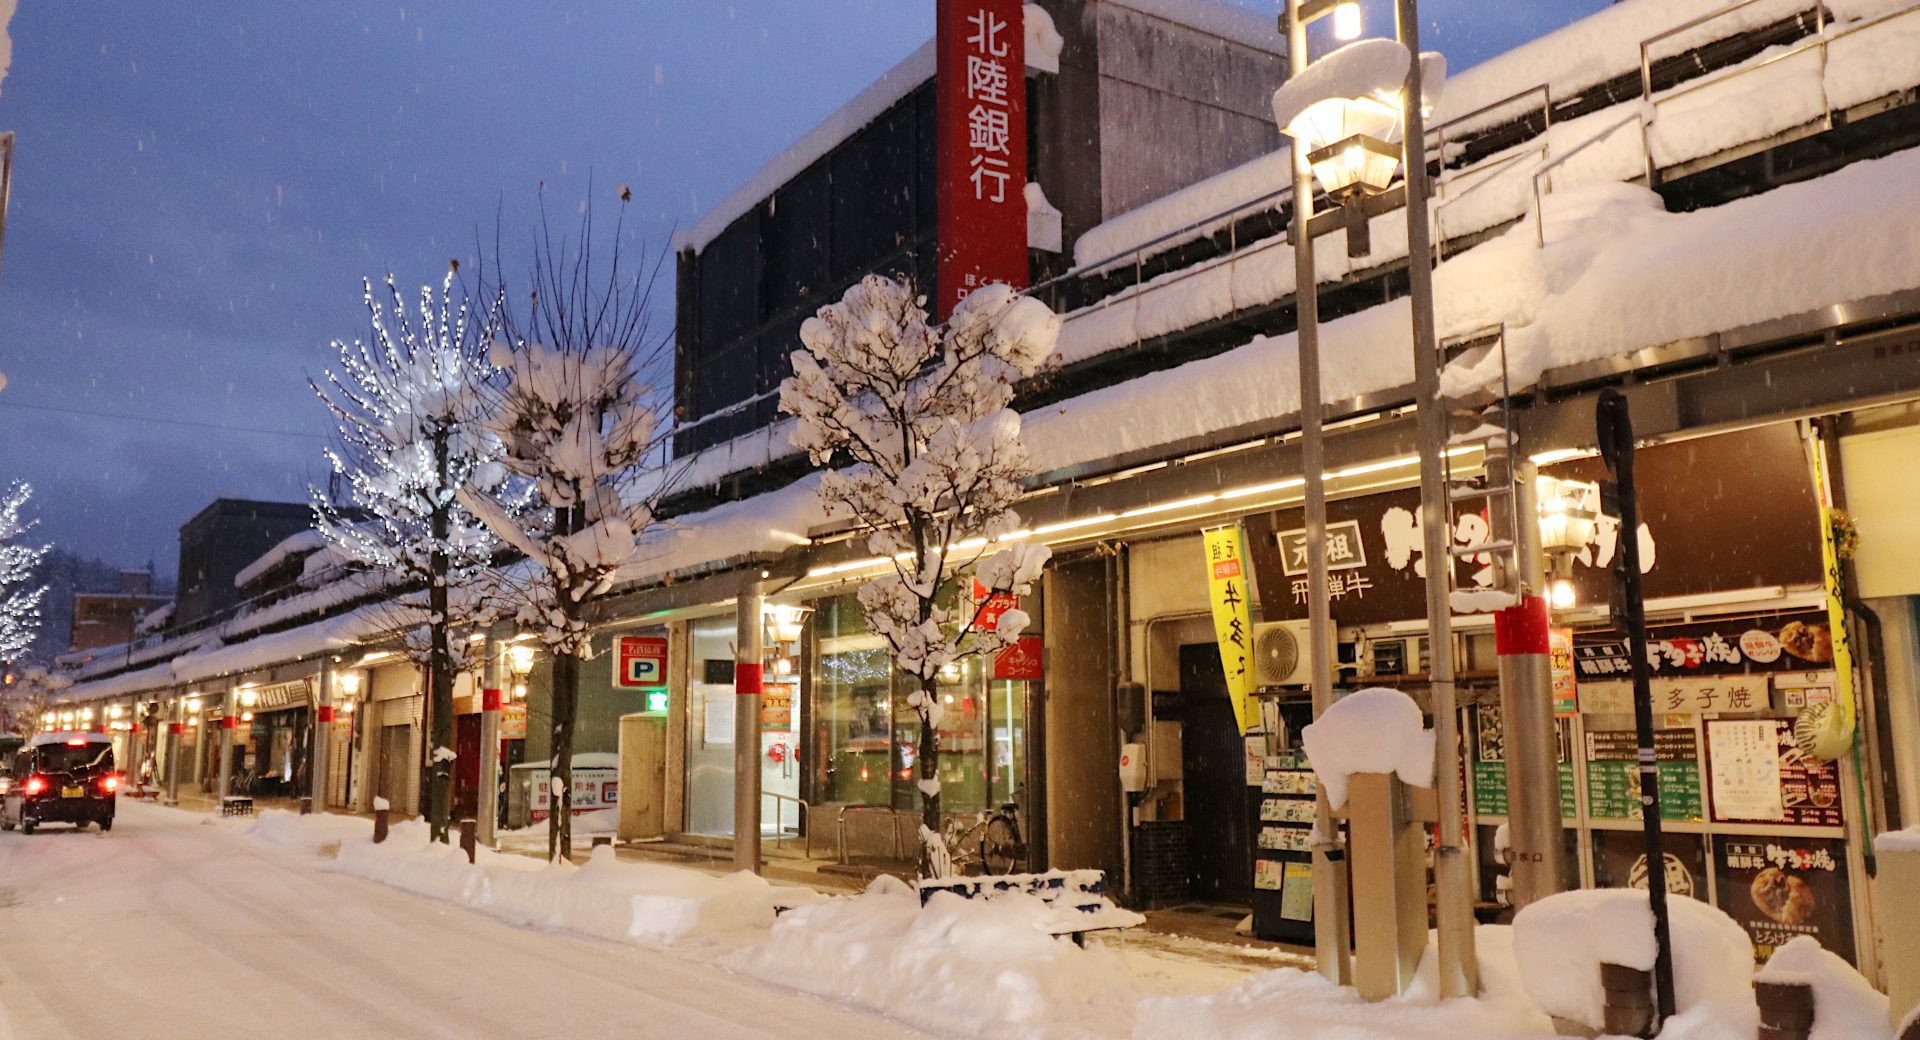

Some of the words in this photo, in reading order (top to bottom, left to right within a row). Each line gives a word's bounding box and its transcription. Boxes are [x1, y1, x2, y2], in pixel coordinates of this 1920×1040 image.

[966, 9, 1010, 203] 北陸銀行
[634, 662, 654, 678] P
[1008, 667, 1033, 675] コーナー
[1649, 686, 1751, 710] 多子焼
